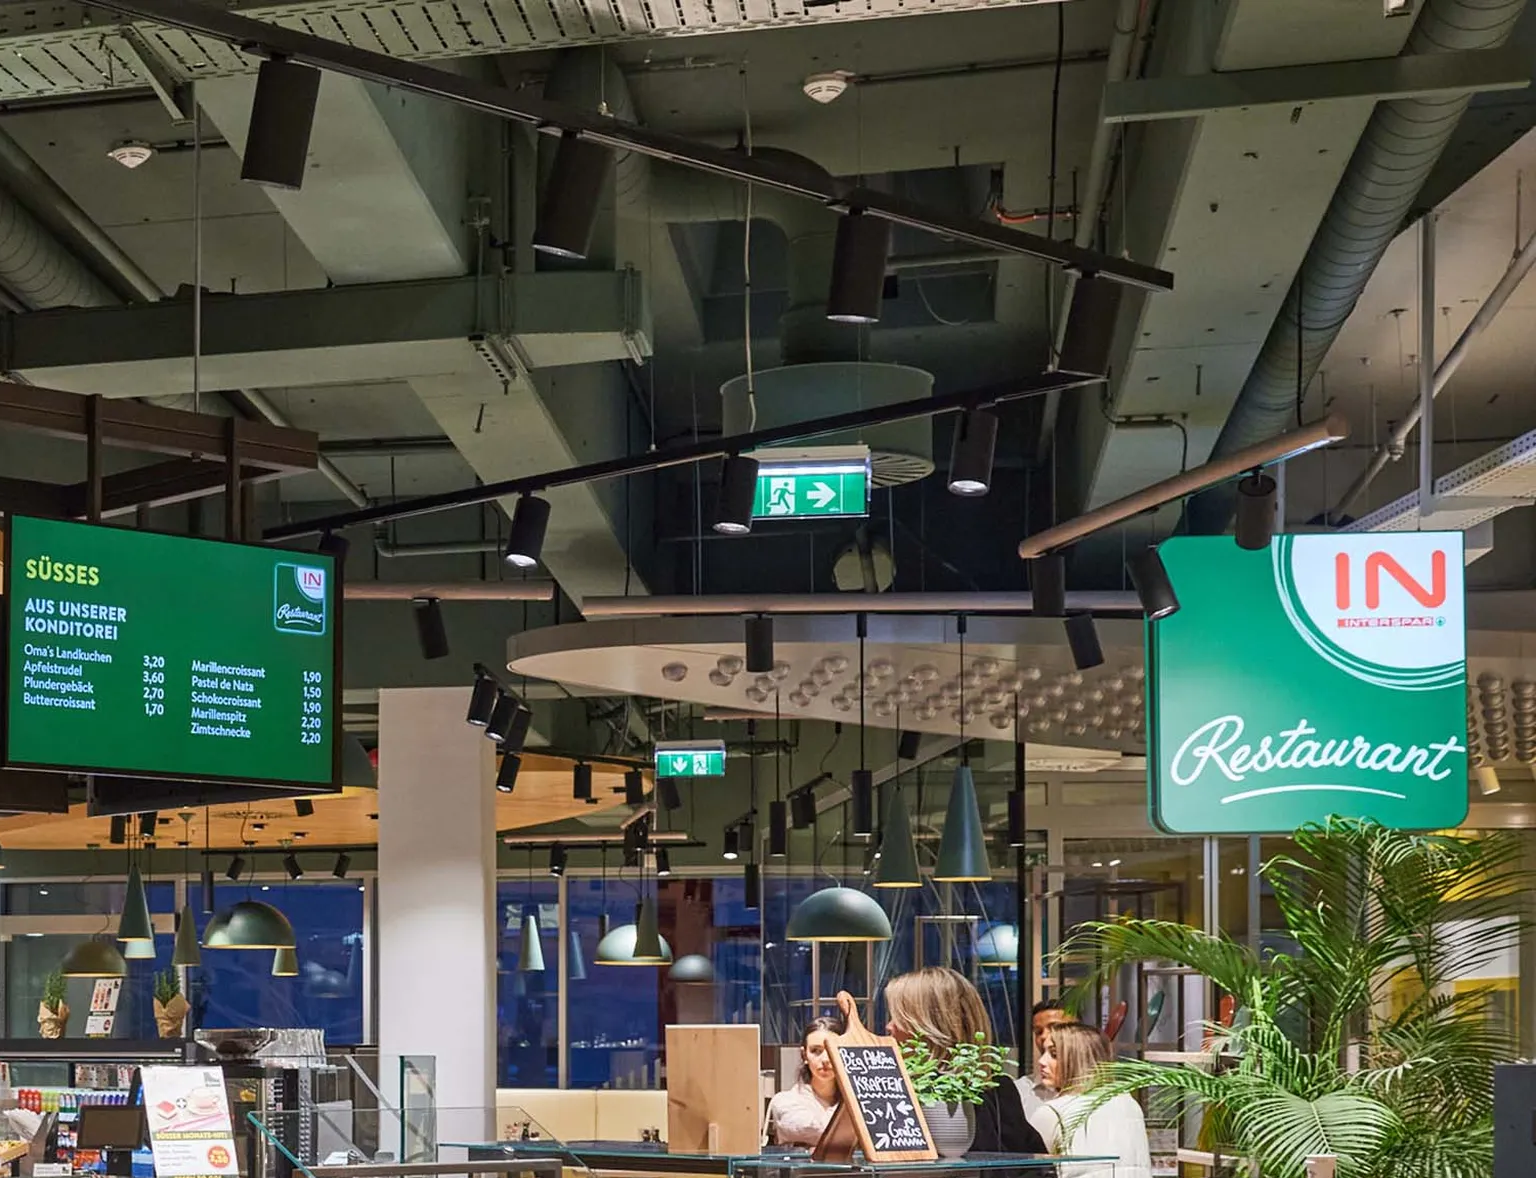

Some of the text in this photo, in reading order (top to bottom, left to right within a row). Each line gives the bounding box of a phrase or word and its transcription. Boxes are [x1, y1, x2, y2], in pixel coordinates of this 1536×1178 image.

[26, 555, 100, 586] SÜSSES
[303, 571, 322, 586] IN
[1335, 550, 1446, 610] IN
[25, 597, 127, 623] AUS UNSERER
[276, 603, 324, 623] Restaurant
[25, 616, 118, 640] KONDITOREI
[1344, 617, 1434, 628] INTERSPAR
[24, 643, 112, 664] Oma's Landkuchen
[143, 655, 165, 669] 3,20
[23, 660, 83, 677] Apfelstrudel
[191, 660, 266, 678] Marillencroissant
[23, 675, 94, 694] Plundergebäck
[142, 671, 164, 685] 3,60
[191, 676, 254, 693] Pastel de Nata
[303, 671, 322, 684] 1,90
[23, 692, 96, 710] Buttercroissant
[143, 687, 164, 701] 2,70
[191, 692, 262, 709] Schokocroissant
[303, 686, 322, 700] 1,50
[144, 702, 164, 717] 1,70
[191, 707, 247, 724] Marillenspitz
[303, 701, 322, 715] 1,90
[191, 722, 251, 738] Zimtschnecke
[301, 716, 321, 730] 2,20
[301, 732, 321, 745] 2,20
[1170, 714, 1465, 786] Restaurant
[853, 1075, 904, 1093] KRAPFEN
